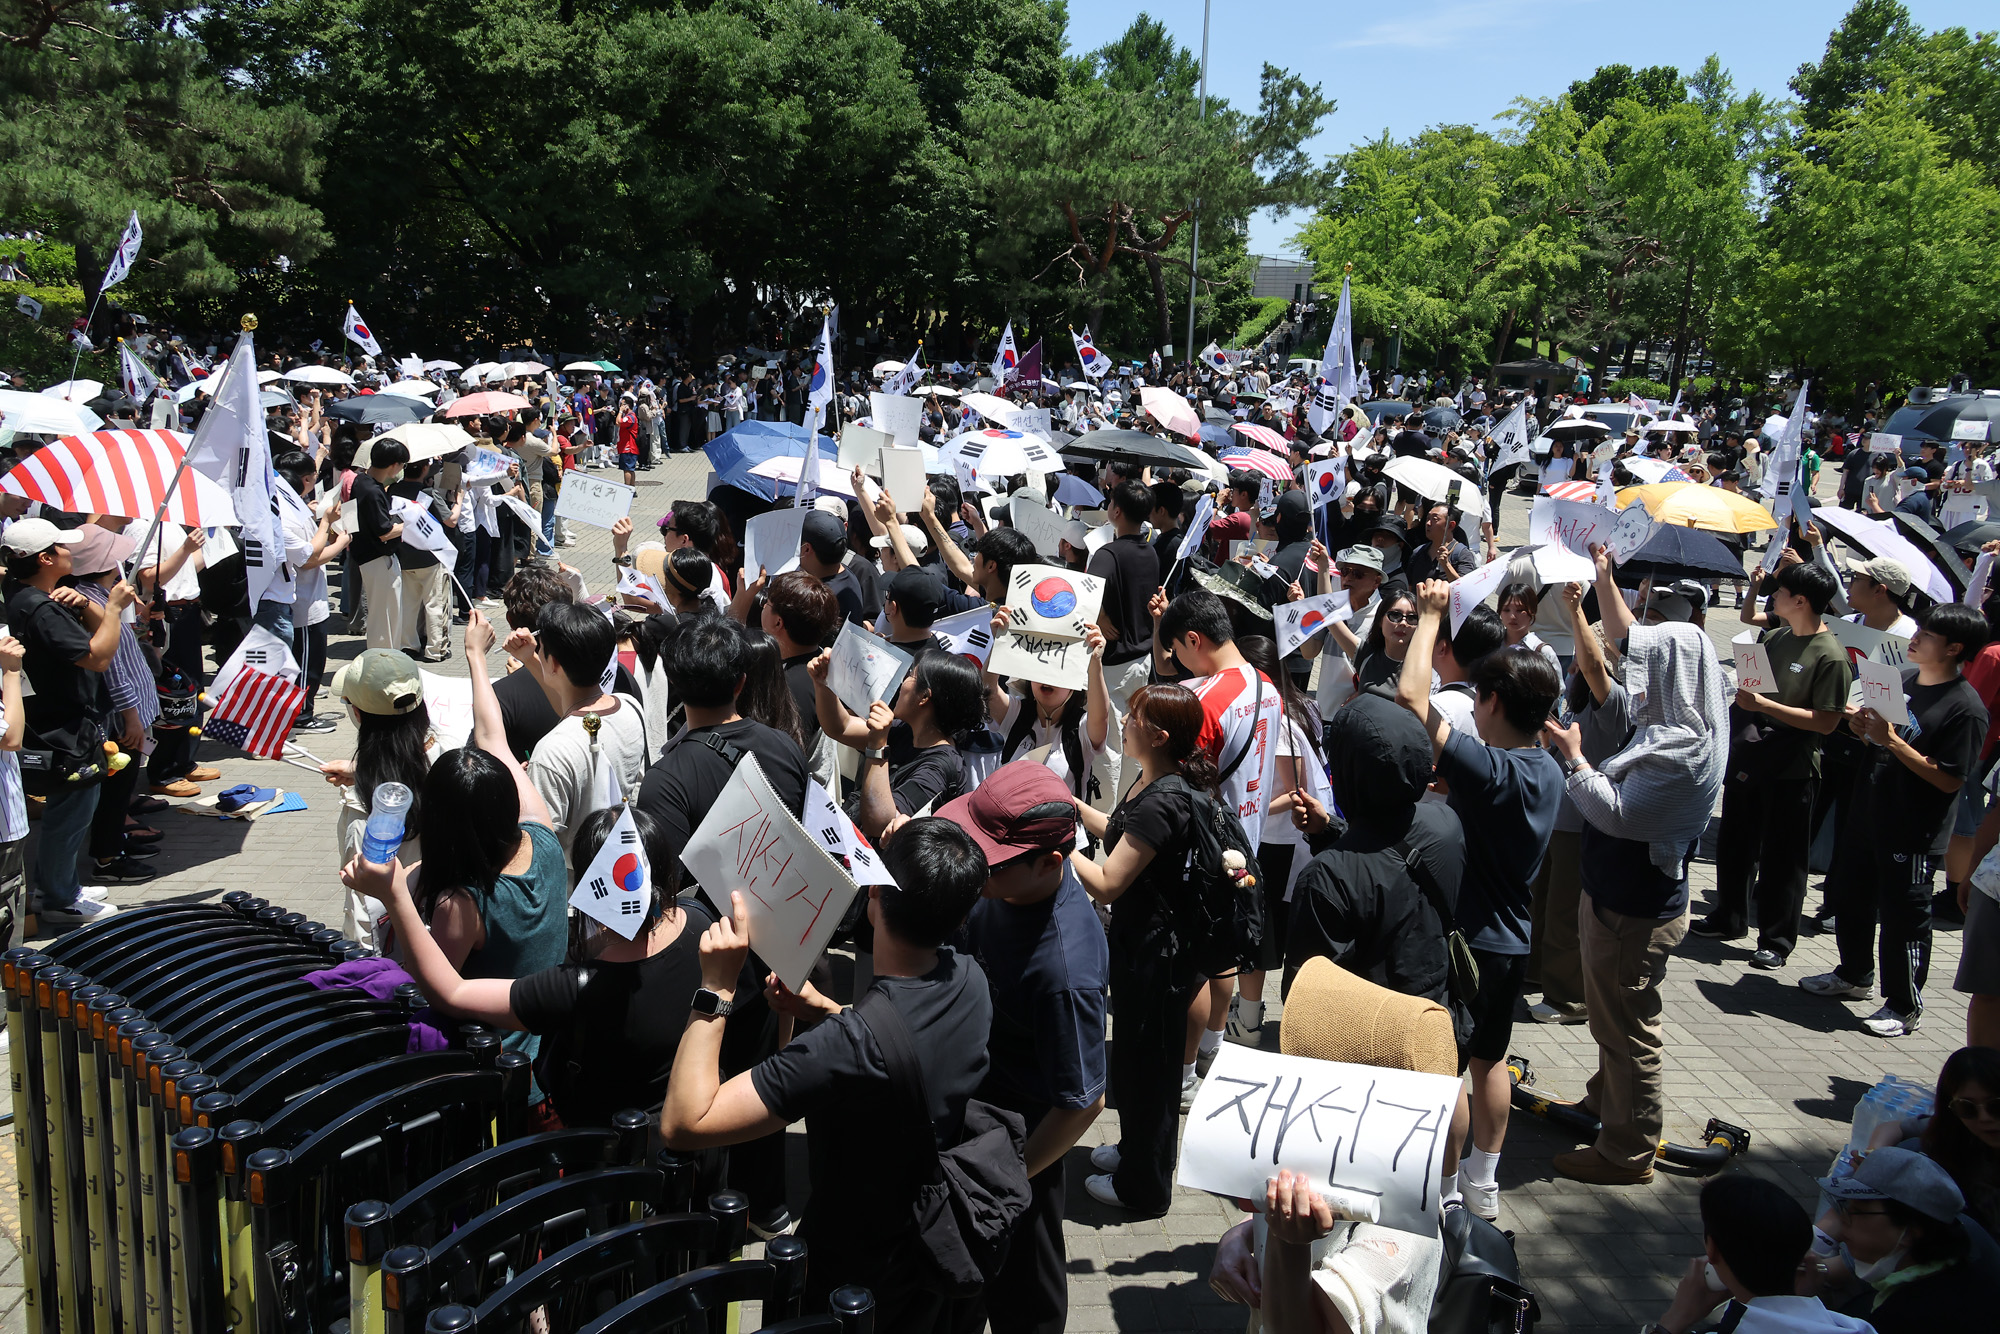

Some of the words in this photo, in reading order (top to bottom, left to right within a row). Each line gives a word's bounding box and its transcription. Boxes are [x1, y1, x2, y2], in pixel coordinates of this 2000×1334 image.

[1011, 414, 1043, 428] 재선거
[570, 479, 617, 503] 재선거
[1010, 633, 1069, 670] 재선거
[718, 778, 833, 946] 재선거
[1205, 1075, 1448, 1212] 재선거
